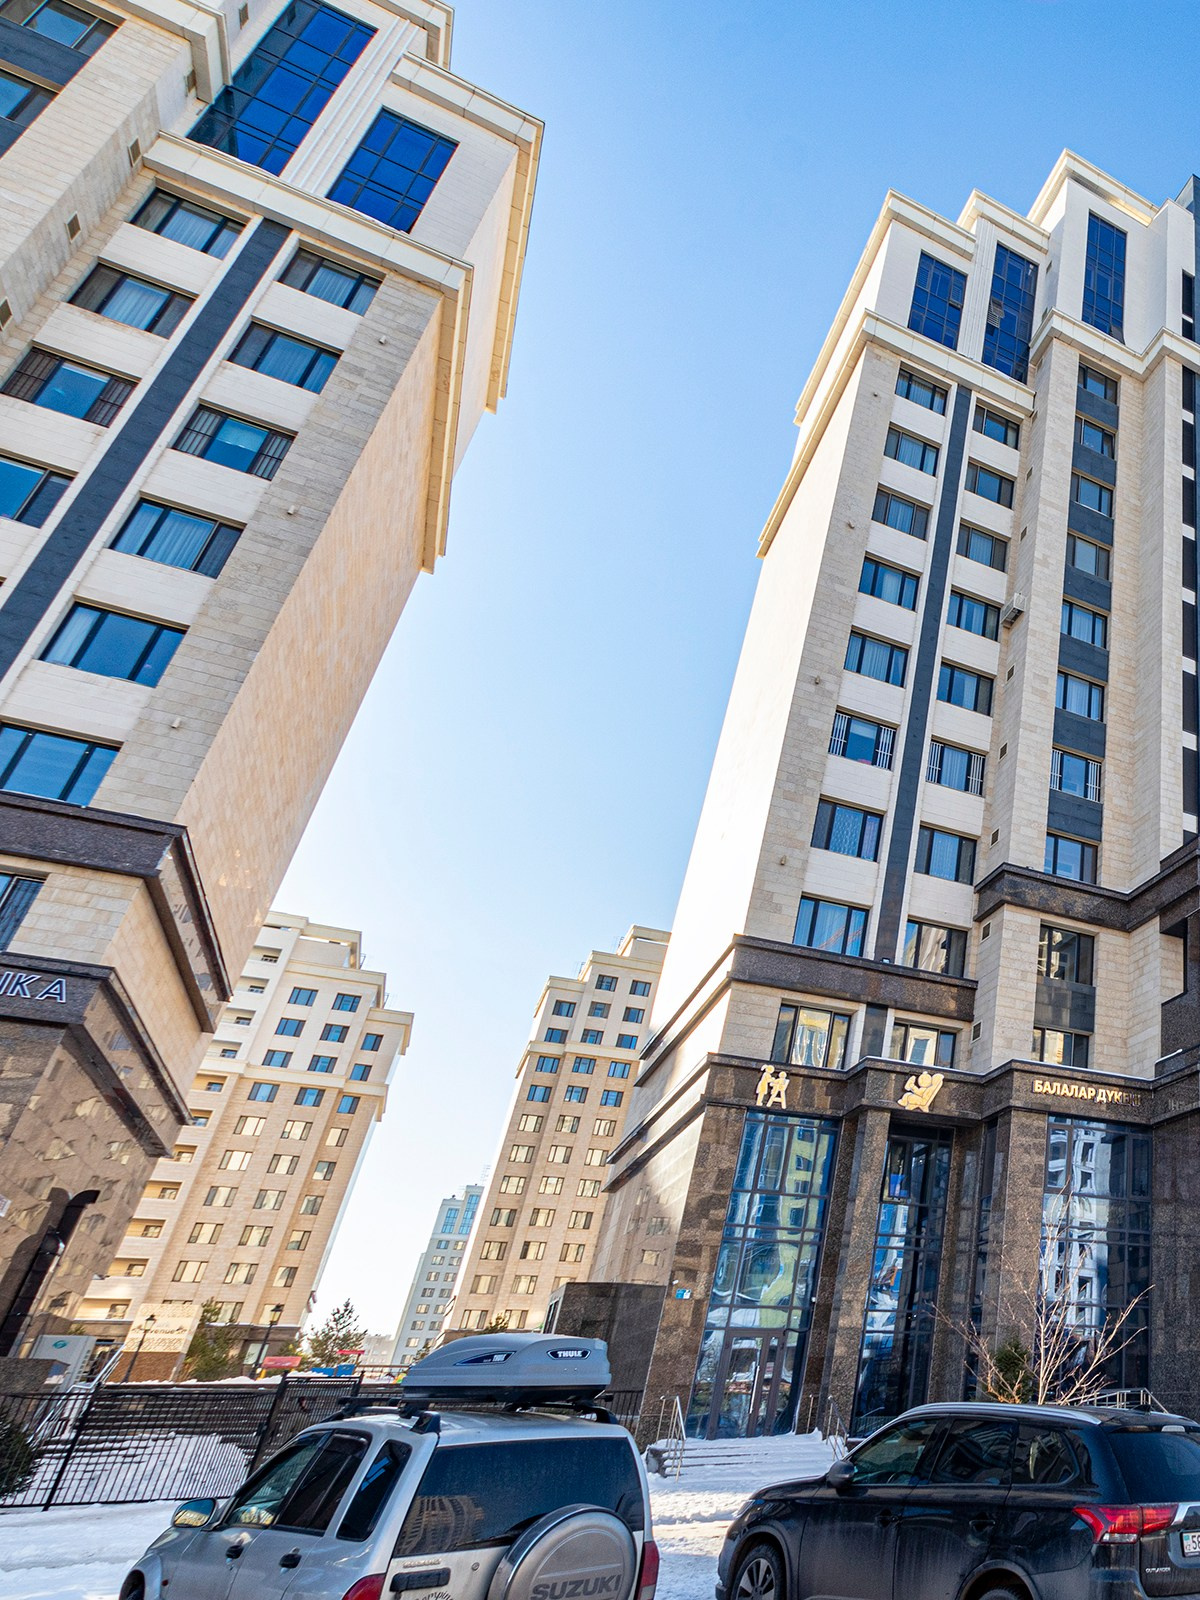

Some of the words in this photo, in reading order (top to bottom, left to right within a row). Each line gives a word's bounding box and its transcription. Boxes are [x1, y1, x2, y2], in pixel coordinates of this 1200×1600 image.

[1033, 1079, 1096, 1099] БАЛАЛАР
[557, 1350, 582, 1358] THULE
[529, 1574, 623, 1600] SUZUKI
